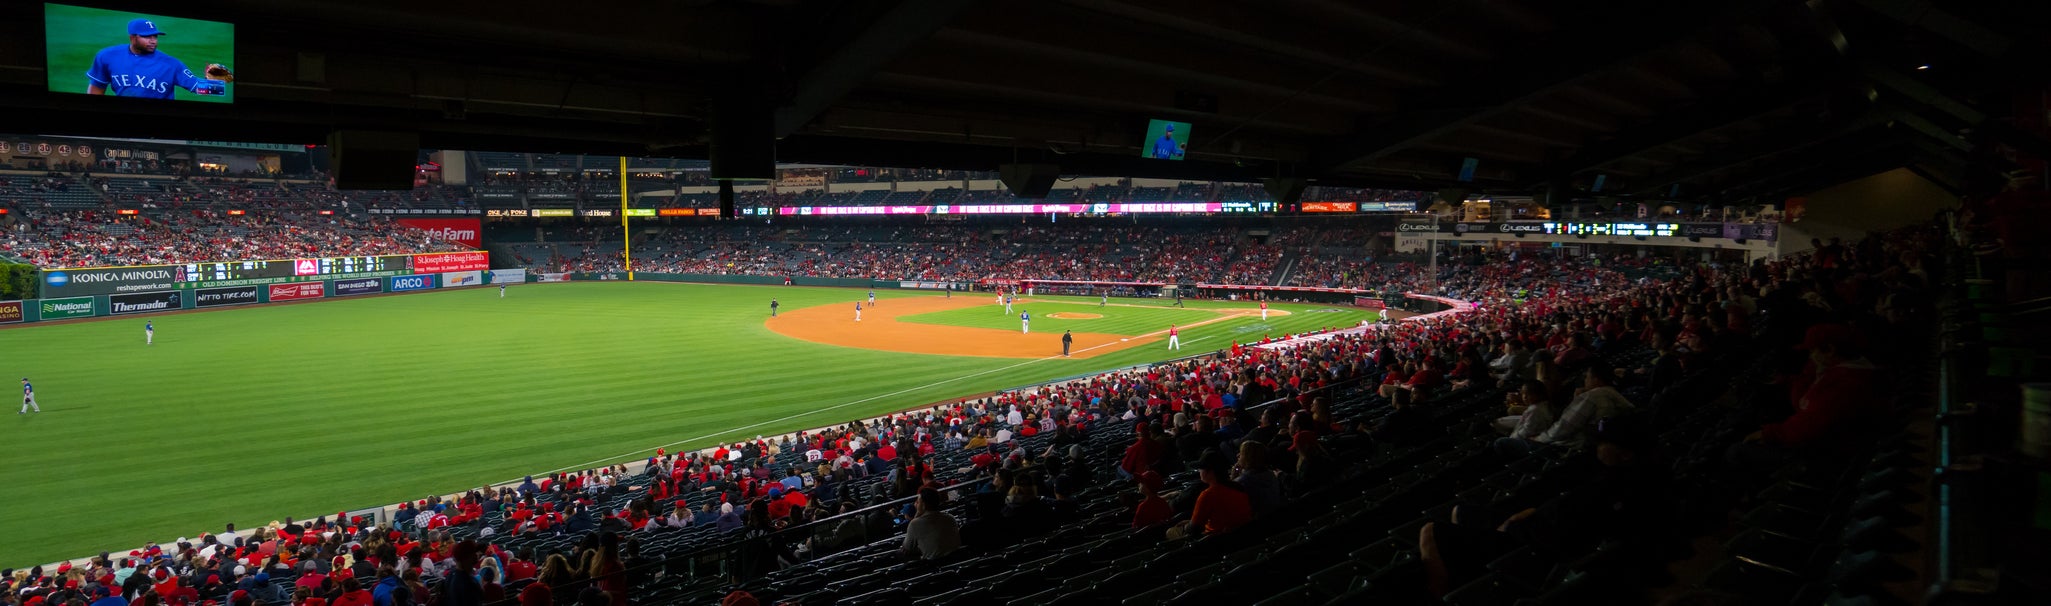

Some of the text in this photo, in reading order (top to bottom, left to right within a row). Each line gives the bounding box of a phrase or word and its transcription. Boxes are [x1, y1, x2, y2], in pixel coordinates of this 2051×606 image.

[111, 74, 169, 93] TEXAS
[104, 148, 159, 160] Captain Morgan
[465, 253, 485, 261] Health
[72, 270, 171, 283] KONICA MINOLTA
[116, 282, 172, 291] reshapework.com
[216, 279, 248, 287] DOMINION
[395, 278, 422, 289] ARCO
[198, 293, 221, 301] NITTO
[54, 301, 92, 311] National
[113, 300, 168, 312] Thermador
